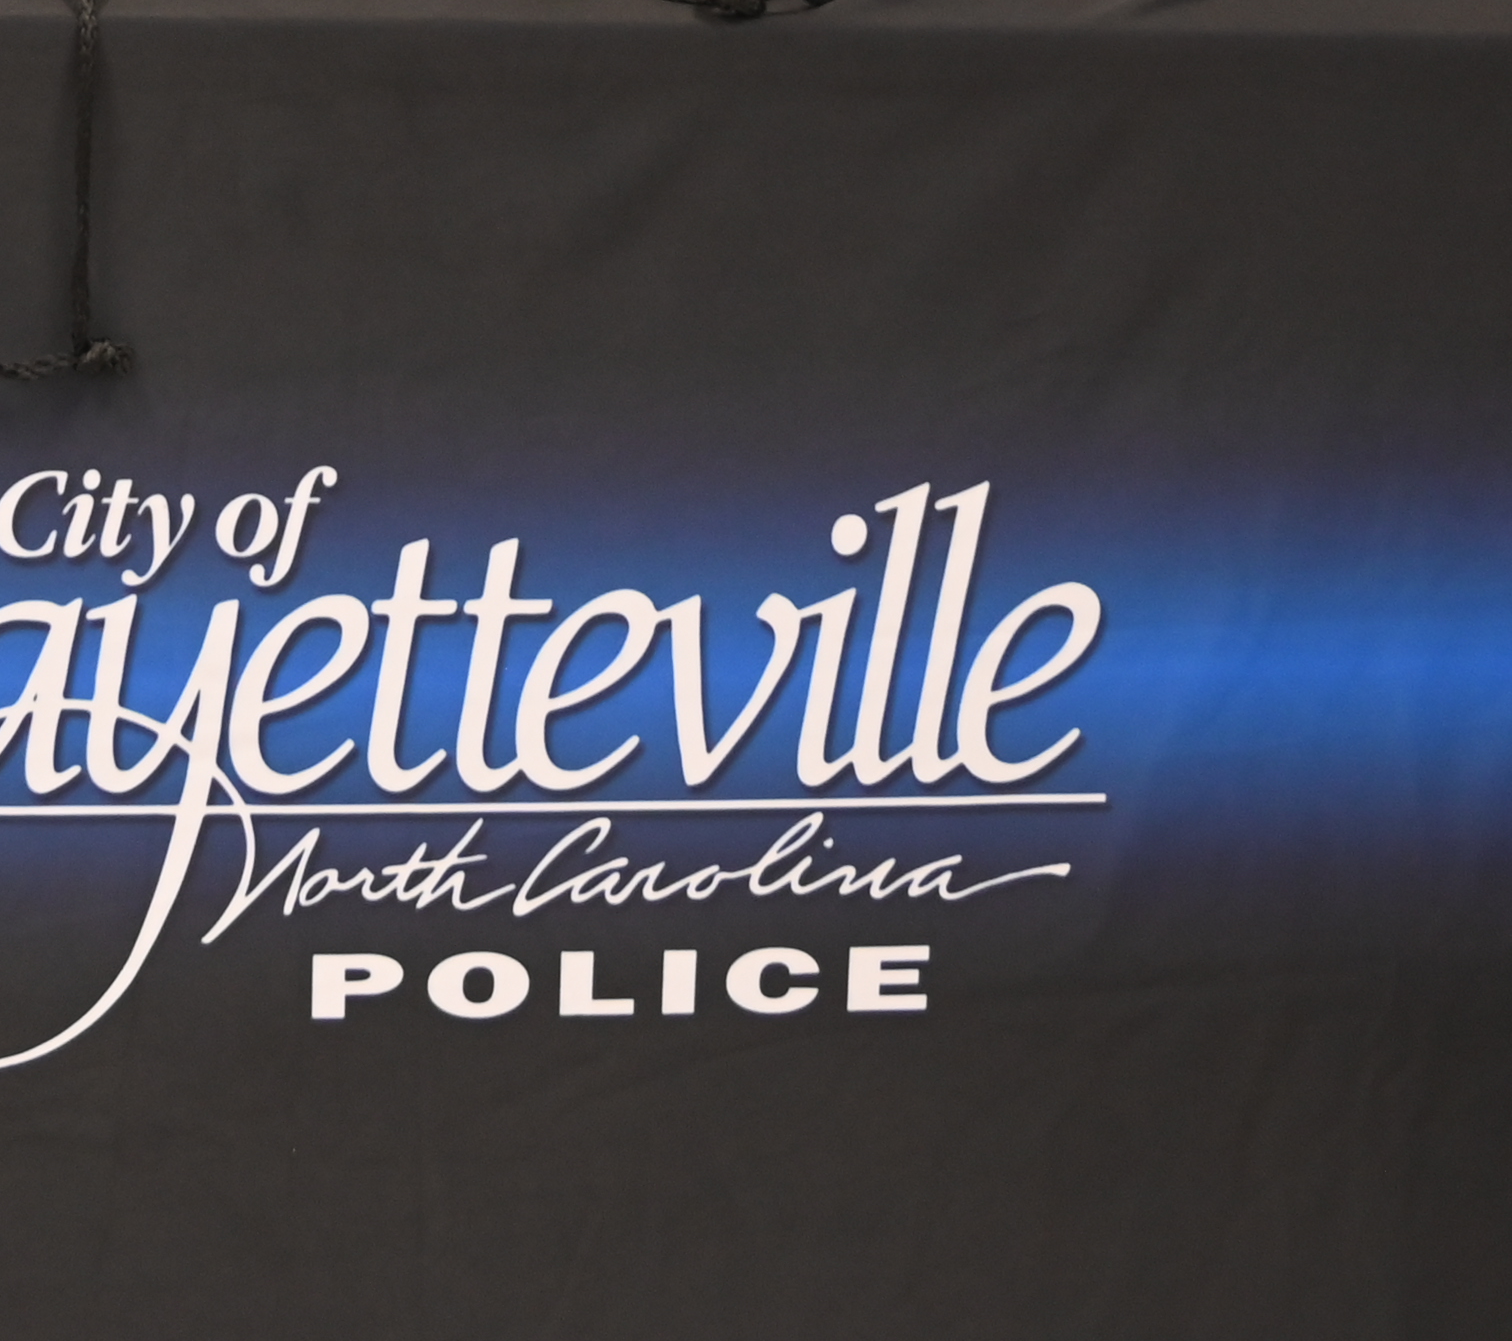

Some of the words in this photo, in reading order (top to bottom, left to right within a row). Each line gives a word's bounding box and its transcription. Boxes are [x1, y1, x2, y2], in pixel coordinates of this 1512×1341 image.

[215, 465, 338, 585] of
[204, 818, 517, 943] North
[513, 811, 1072, 916] Carolina
[311, 945, 930, 1020] POLICE
